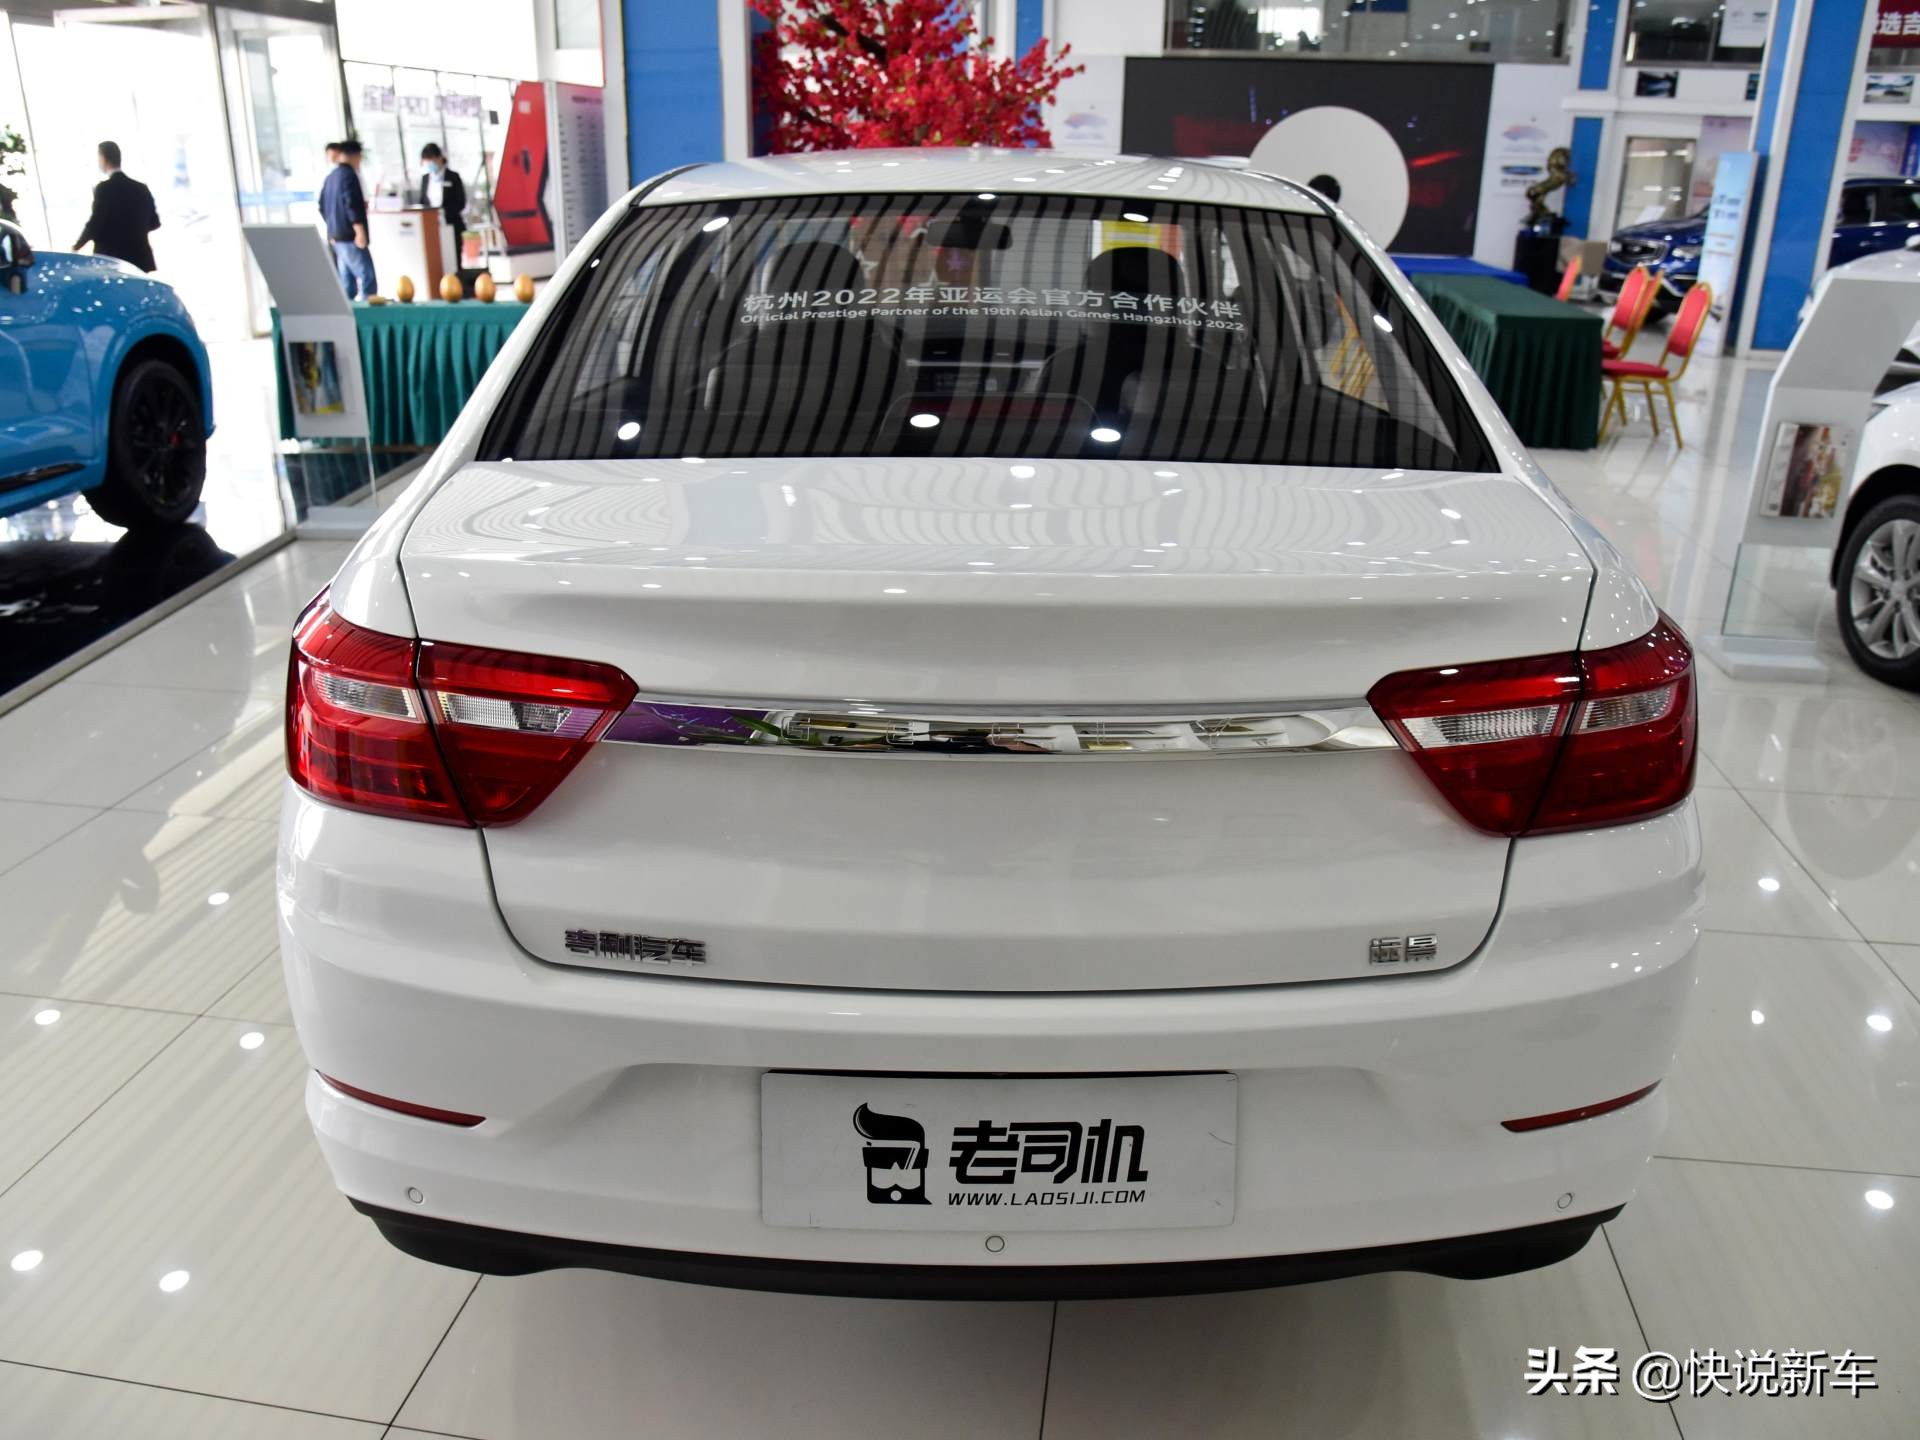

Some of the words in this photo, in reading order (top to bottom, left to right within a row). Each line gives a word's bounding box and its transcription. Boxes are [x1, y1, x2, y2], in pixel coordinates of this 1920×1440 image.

[743, 287, 1242, 318] 杭州2022年亚运会官方合作伙伴
[802, 308, 867, 319] Prestige
[871, 307, 928, 317] Partner
[932, 307, 950, 316] of
[953, 306, 979, 316] the
[982, 306, 1016, 317] 19th
[1019, 307, 1063, 317] Asian
[1066, 308, 1120, 321] Games
[1123, 312, 1202, 326] Hangzhou
[1206, 319, 1244, 331] 2022
[949, 1119, 1148, 1184] 老司机
[949, 1190, 1146, 1206] WWW.LAOSIJI.COM
